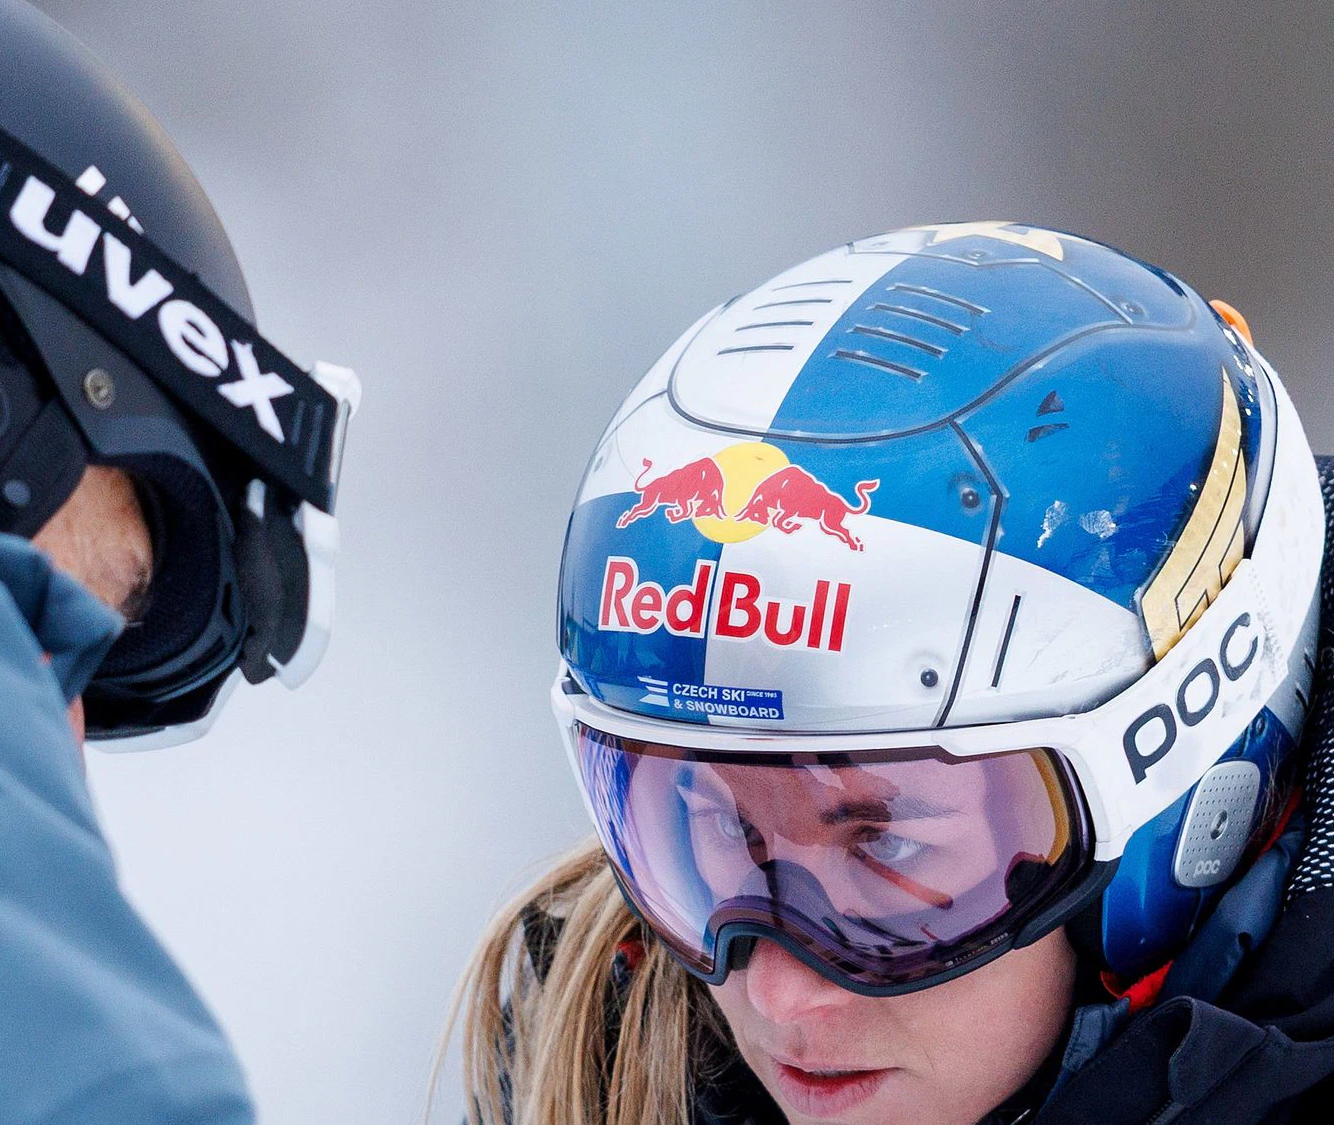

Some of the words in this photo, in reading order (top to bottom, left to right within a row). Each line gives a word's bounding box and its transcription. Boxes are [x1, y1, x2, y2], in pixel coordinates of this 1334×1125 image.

[10, 175, 295, 443] uvex
[600, 560, 714, 635] Red
[714, 570, 852, 653] Bull
[672, 683, 718, 700] CZECH
[721, 689, 746, 702] SKI
[673, 699, 683, 710] &
[686, 700, 780, 719] SNOWBOARD
